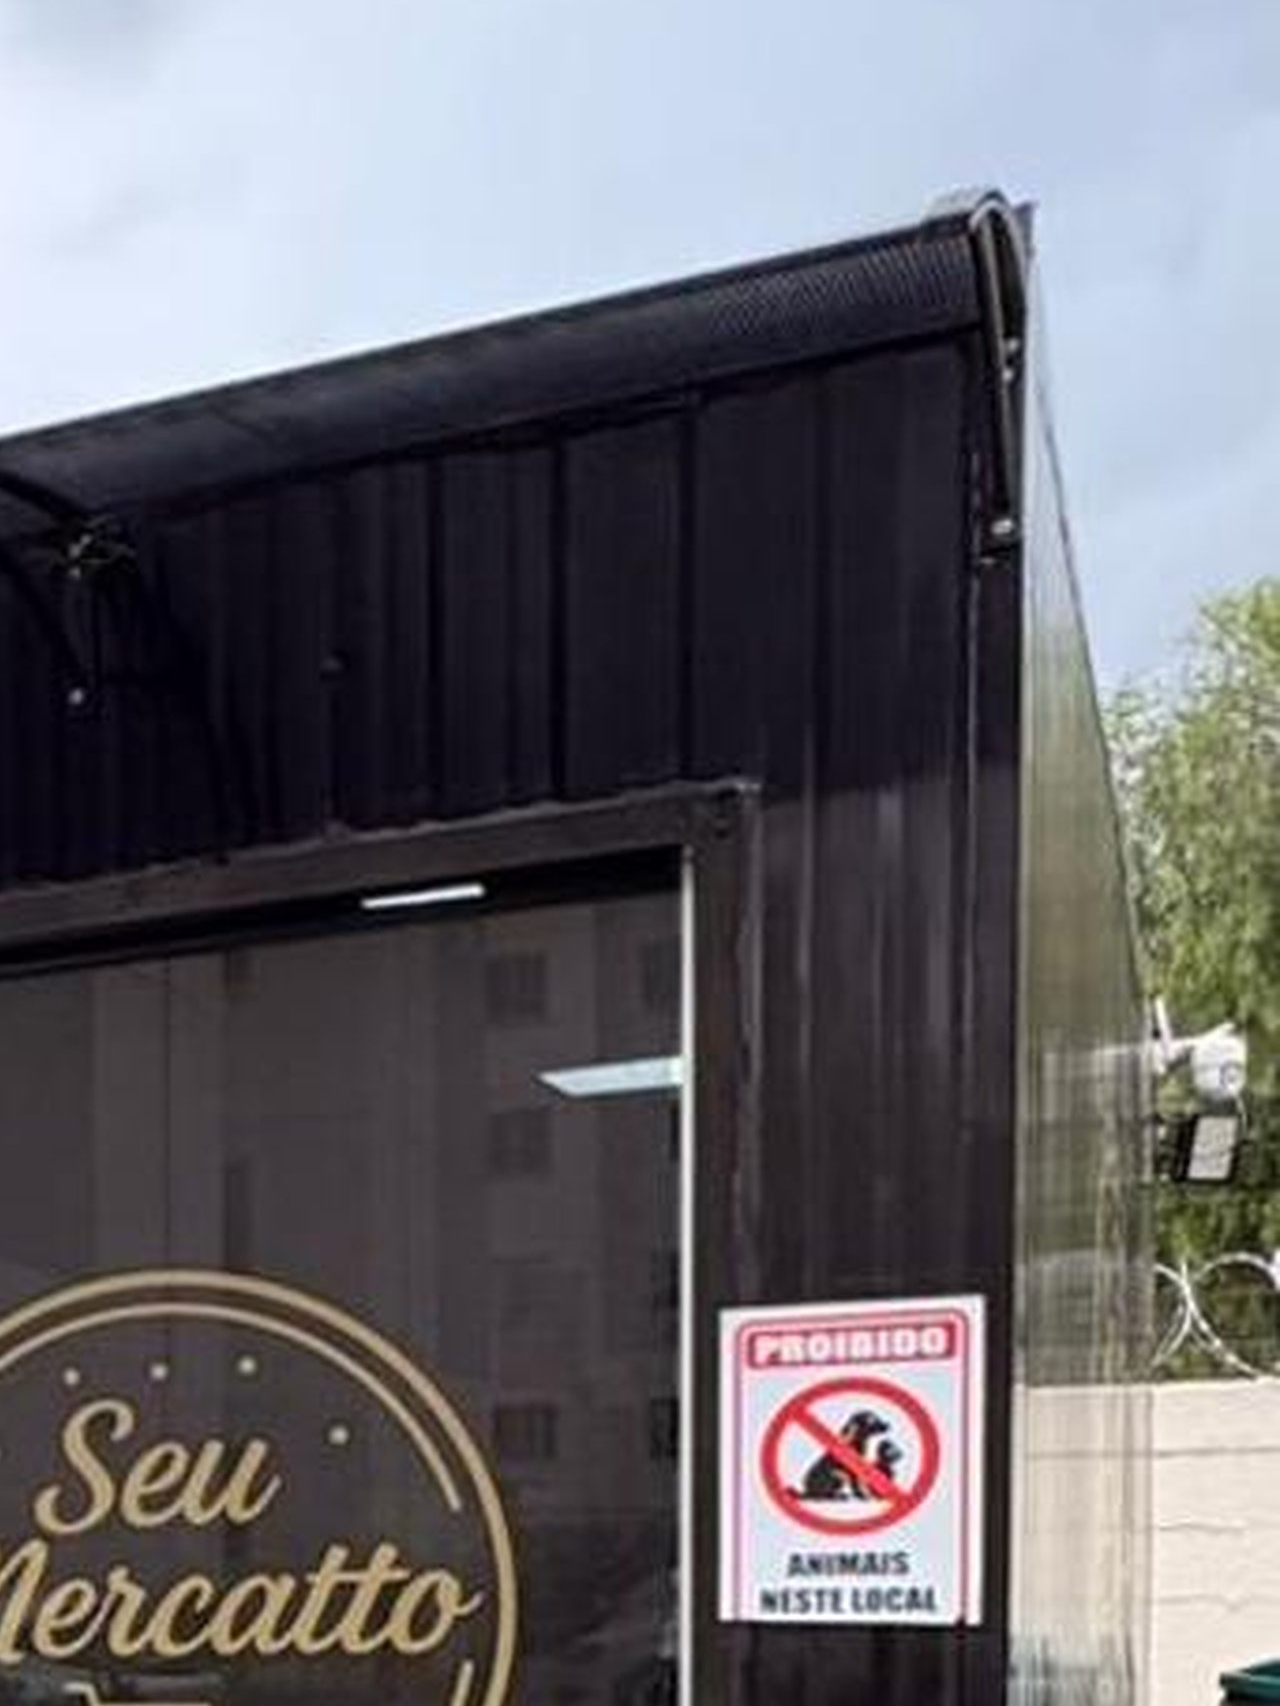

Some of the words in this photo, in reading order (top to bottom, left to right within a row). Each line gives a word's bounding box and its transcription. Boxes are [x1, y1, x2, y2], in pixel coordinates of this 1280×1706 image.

[754, 1326, 948, 1363] PROIBIDO
[35, 1398, 280, 1534] Seu
[787, 1552, 911, 1579] ANIMAIS
[760, 1588, 845, 1614] NESTE
[851, 1587, 939, 1613] LOCAL
